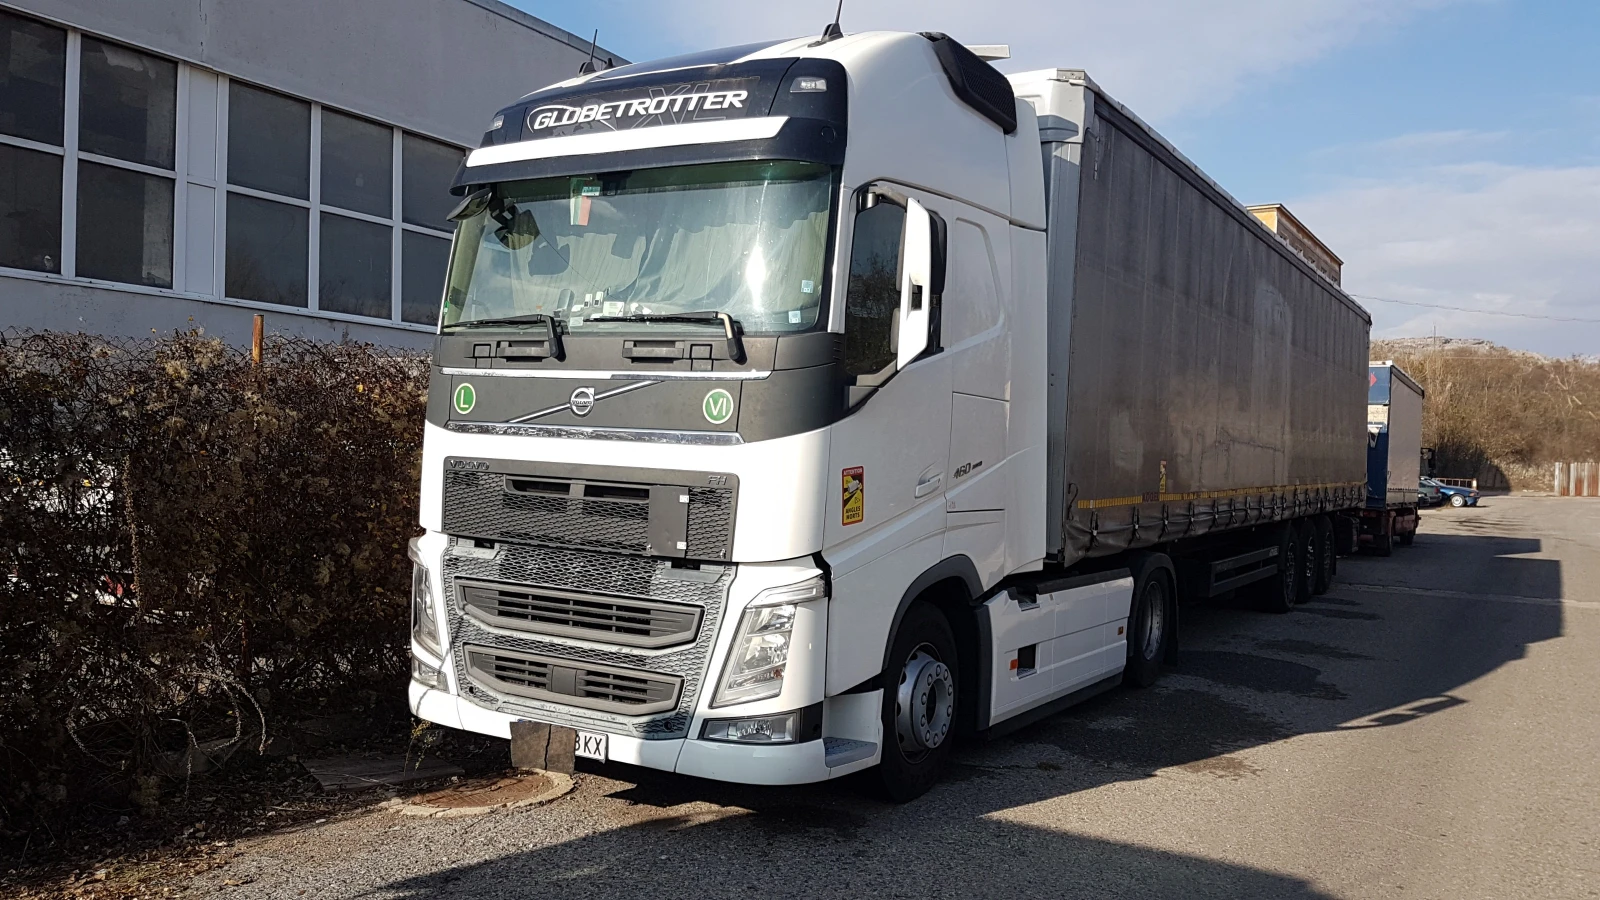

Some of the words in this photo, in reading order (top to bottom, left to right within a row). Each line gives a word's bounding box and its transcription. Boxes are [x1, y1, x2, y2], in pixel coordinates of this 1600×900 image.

[533, 90, 748, 130] GLOBETROTTER
[459, 389, 469, 408] L
[449, 459, 490, 471] VOLVO
[952, 462, 972, 480] 460
[707, 474, 728, 486] FH
[845, 505, 861, 514] ANGLES
